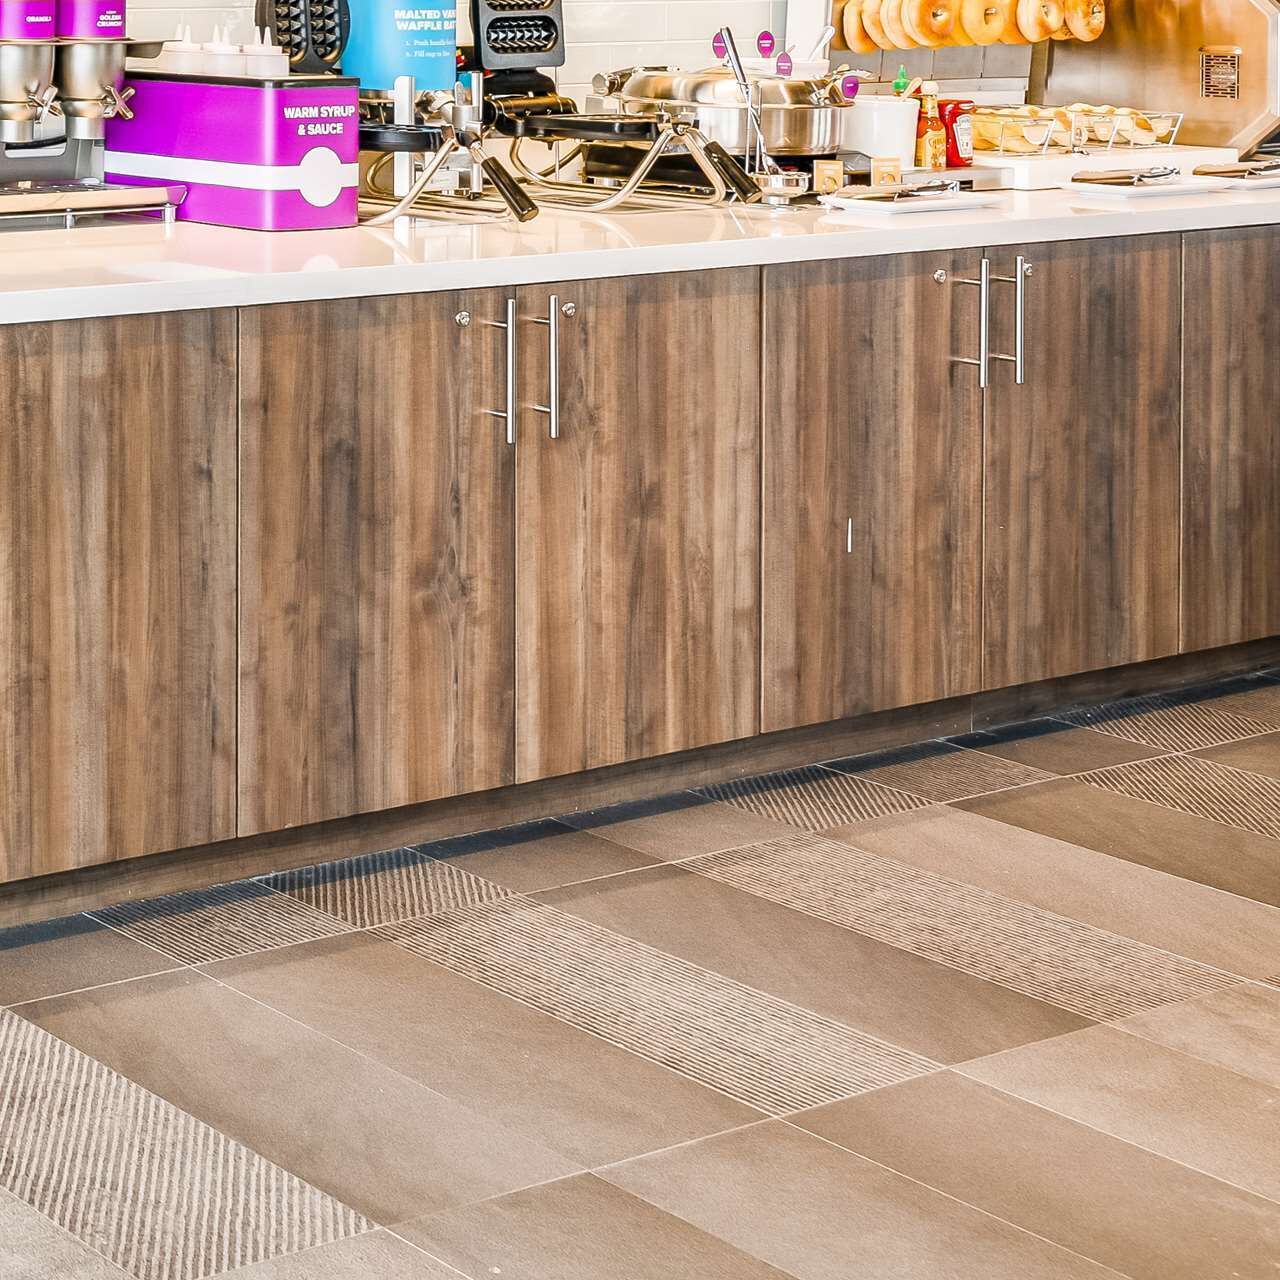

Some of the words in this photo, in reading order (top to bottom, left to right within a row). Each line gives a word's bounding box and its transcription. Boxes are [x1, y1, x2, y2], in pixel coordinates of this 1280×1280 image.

[394, 9, 440, 19] MALTED
[396, 20, 442, 30] WAFFLE
[284, 106, 318, 118] WARM
[320, 105, 356, 118] SYRUP
[298, 124, 306, 136] &
[307, 123, 344, 135] SAUCE
